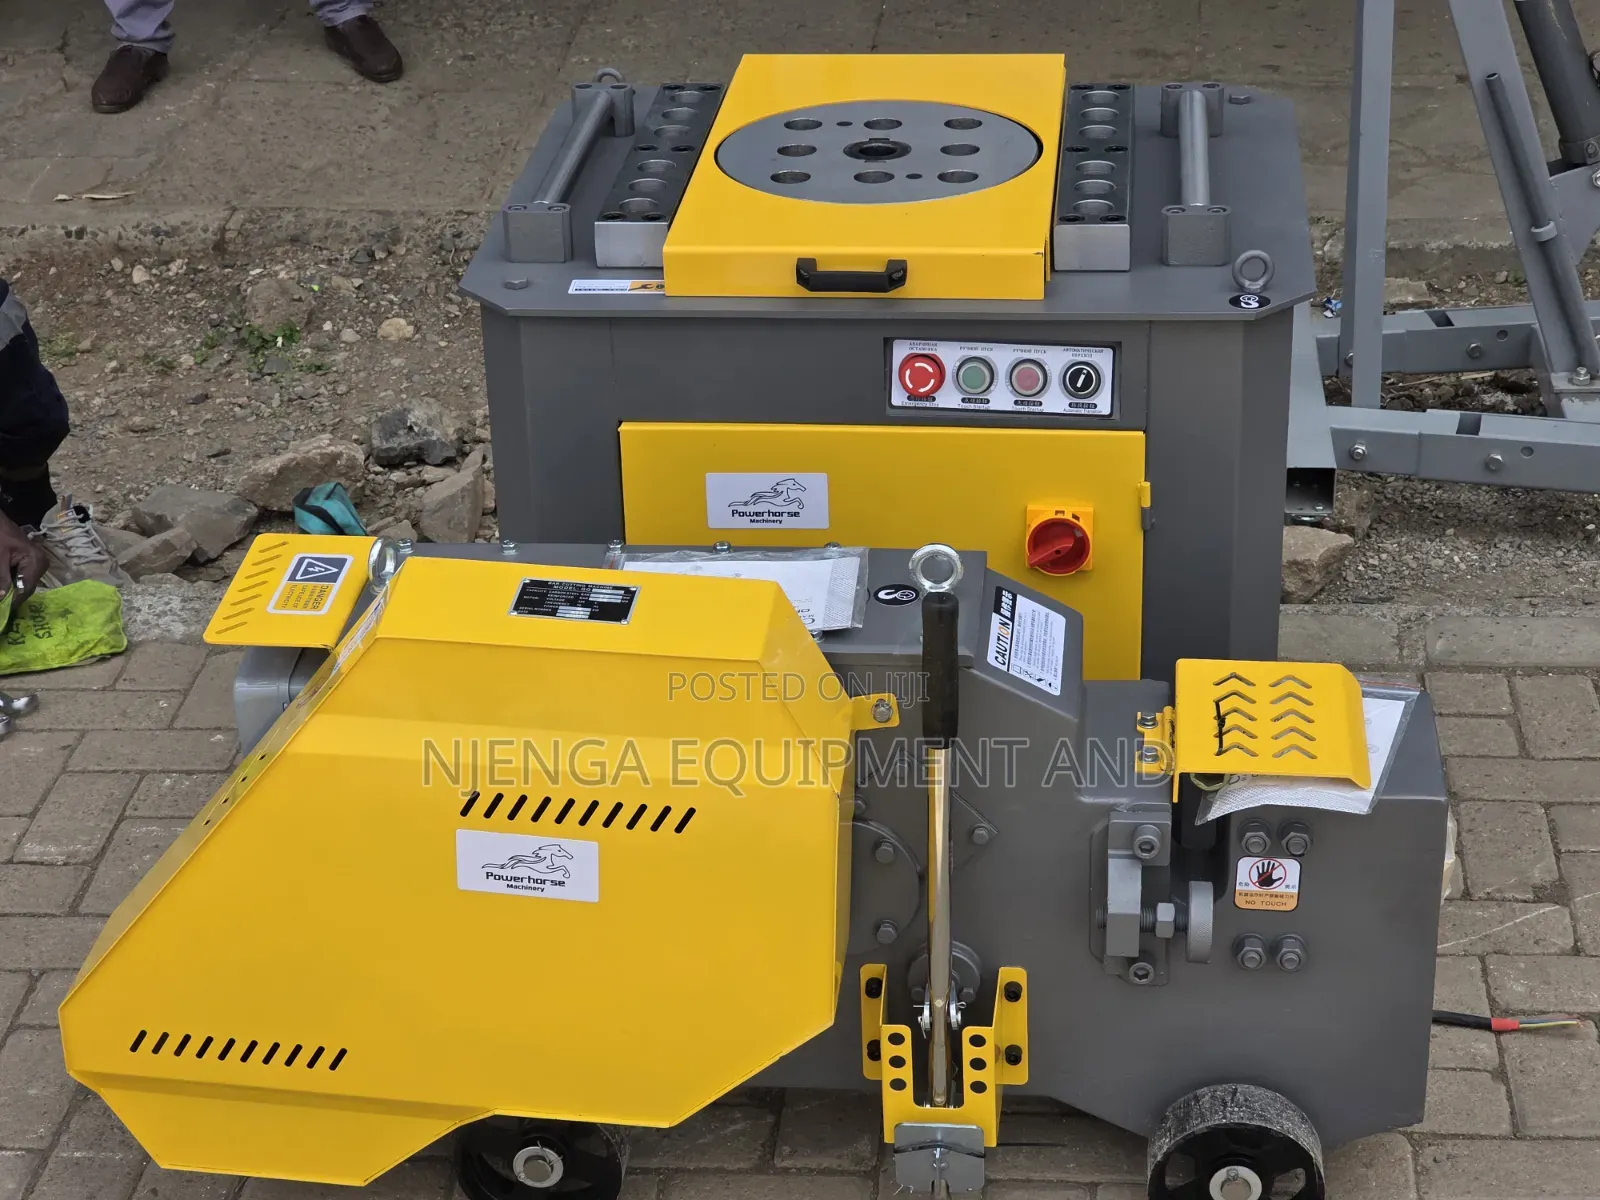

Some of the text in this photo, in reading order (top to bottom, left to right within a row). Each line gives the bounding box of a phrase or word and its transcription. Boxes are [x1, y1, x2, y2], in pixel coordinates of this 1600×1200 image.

[731, 509, 801, 518] Powerhorse
[312, 585, 329, 609] DANGER
[994, 618, 1011, 666] CAUTION
[485, 871, 566, 888] Powerhorse
[506, 883, 545, 893] Machinery
